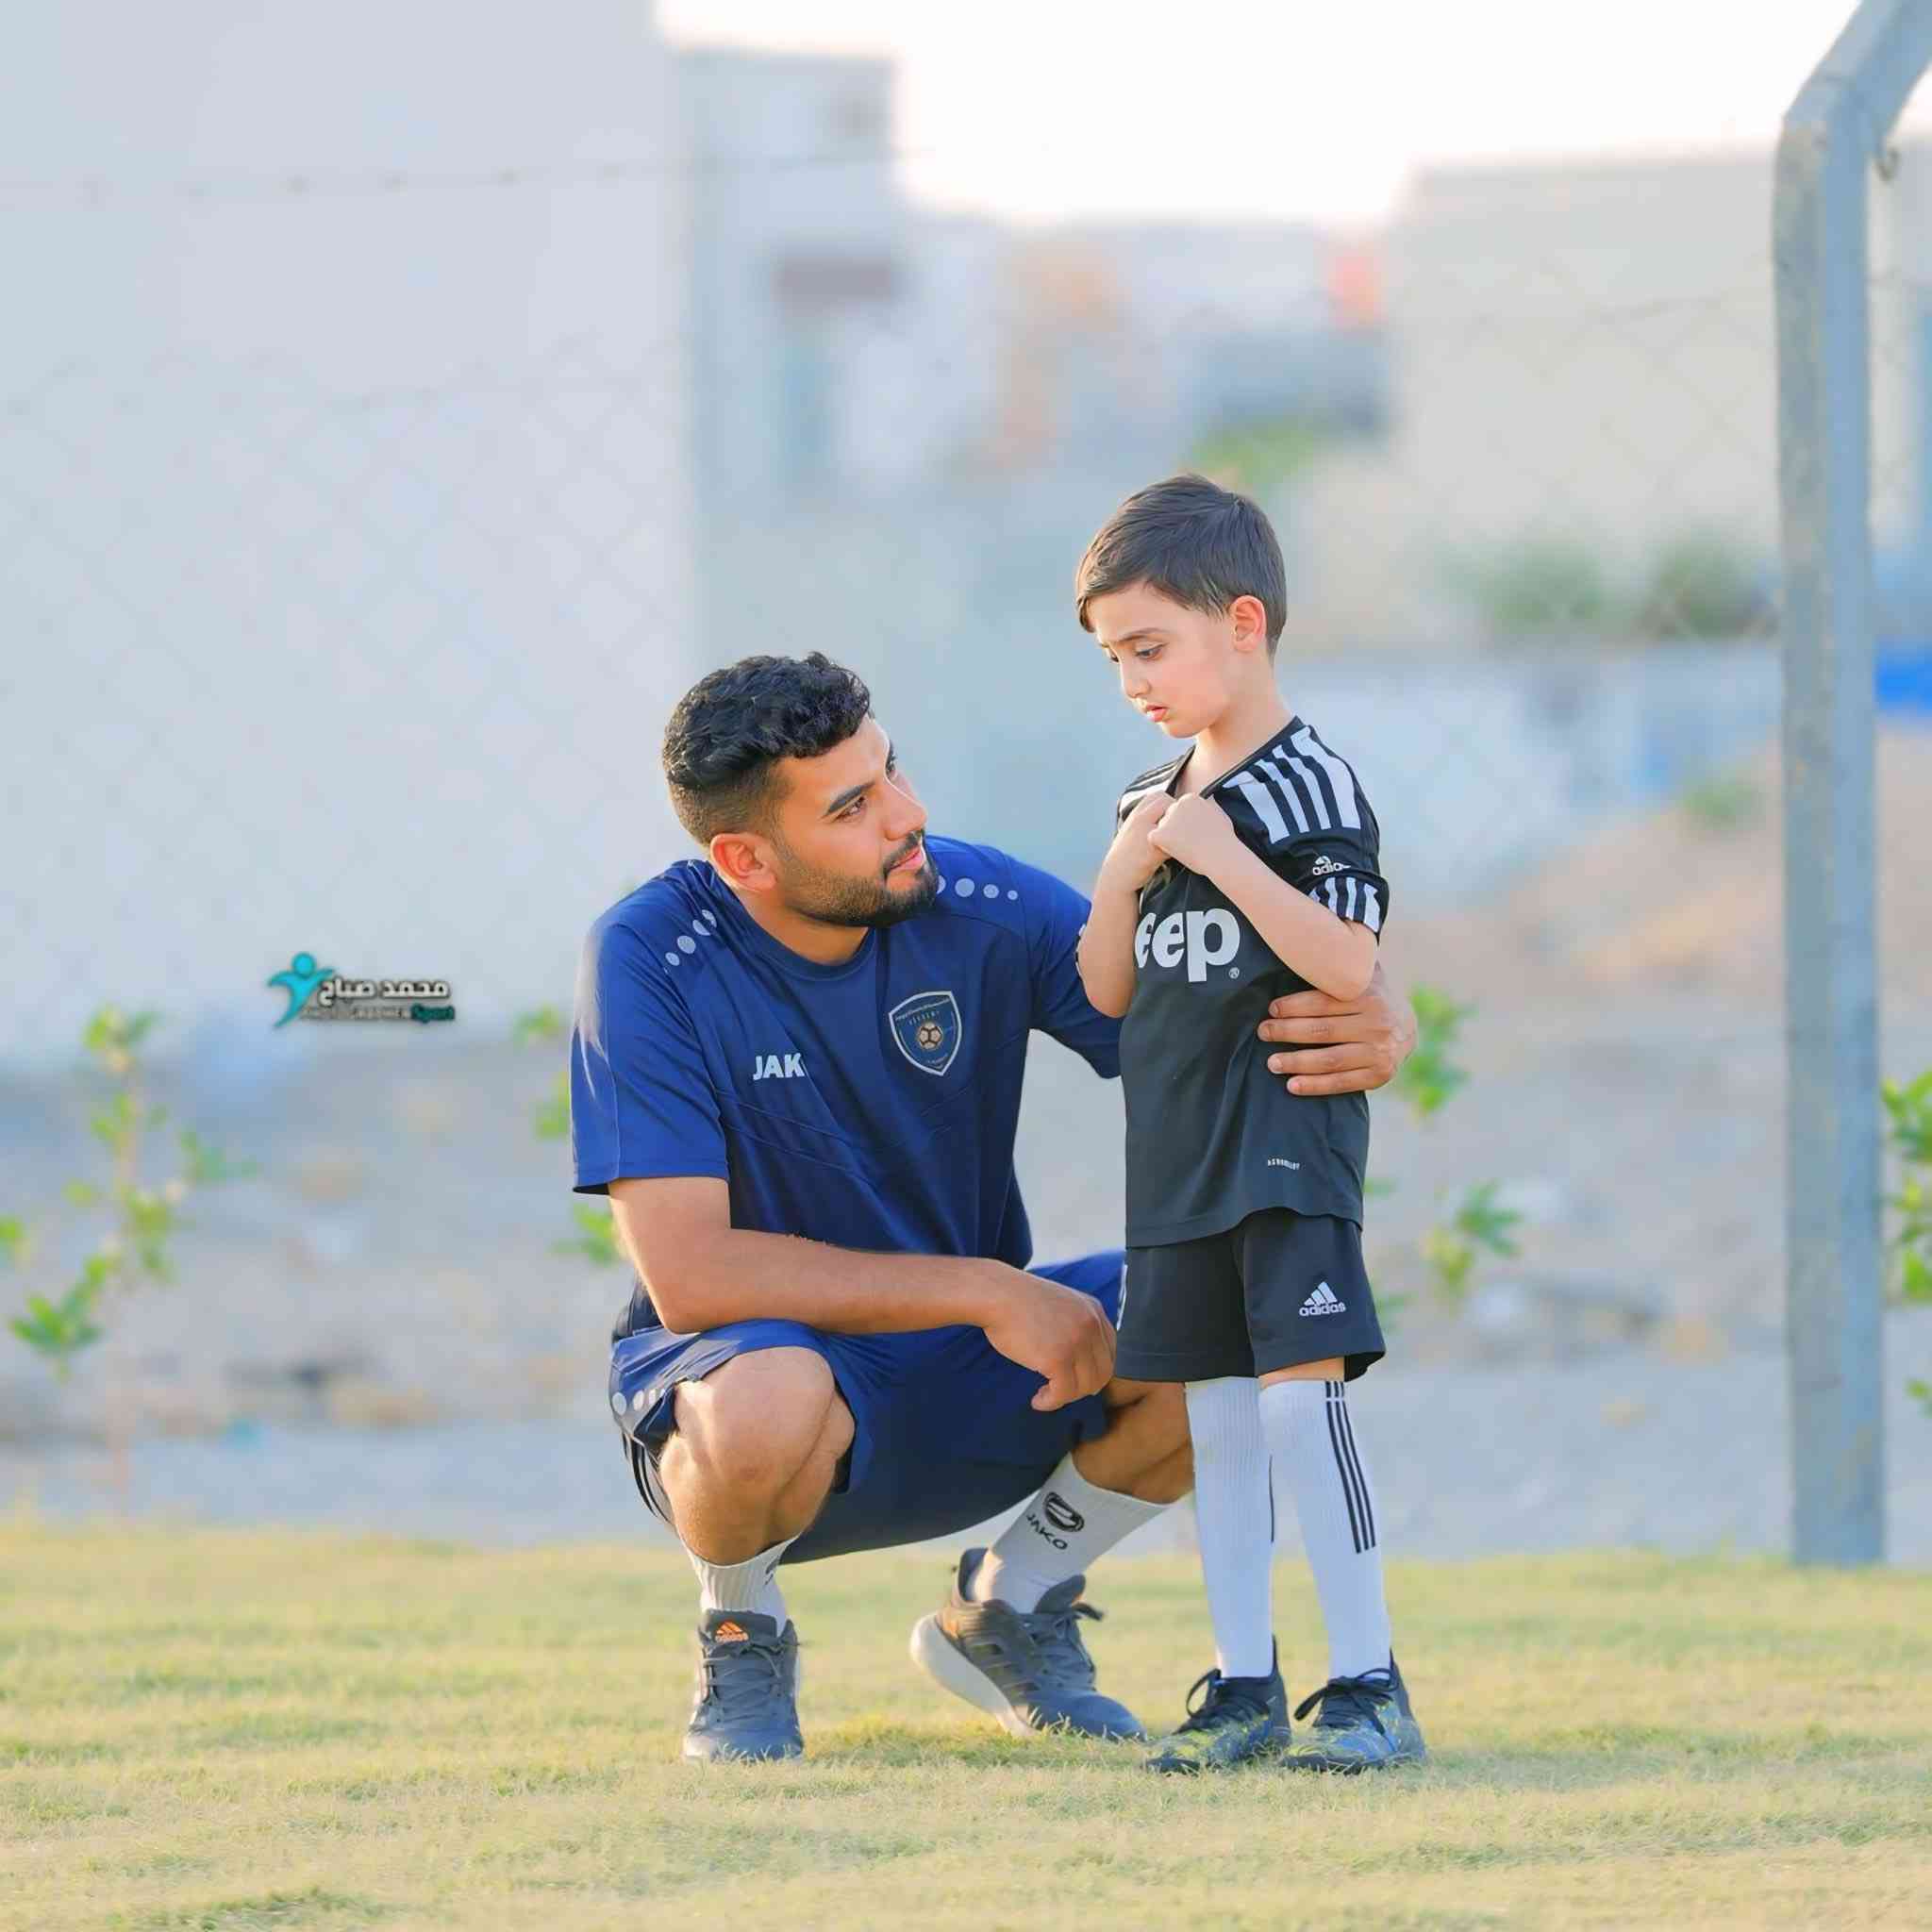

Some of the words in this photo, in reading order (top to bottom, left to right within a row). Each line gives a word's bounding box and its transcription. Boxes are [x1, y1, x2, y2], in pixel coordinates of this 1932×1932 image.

[1134, 908, 1241, 983] eep
[753, 1052, 806, 1081] JAK
[1298, 1301, 1347, 1317] adidas
[1026, 1512, 1069, 1550] JAKO
